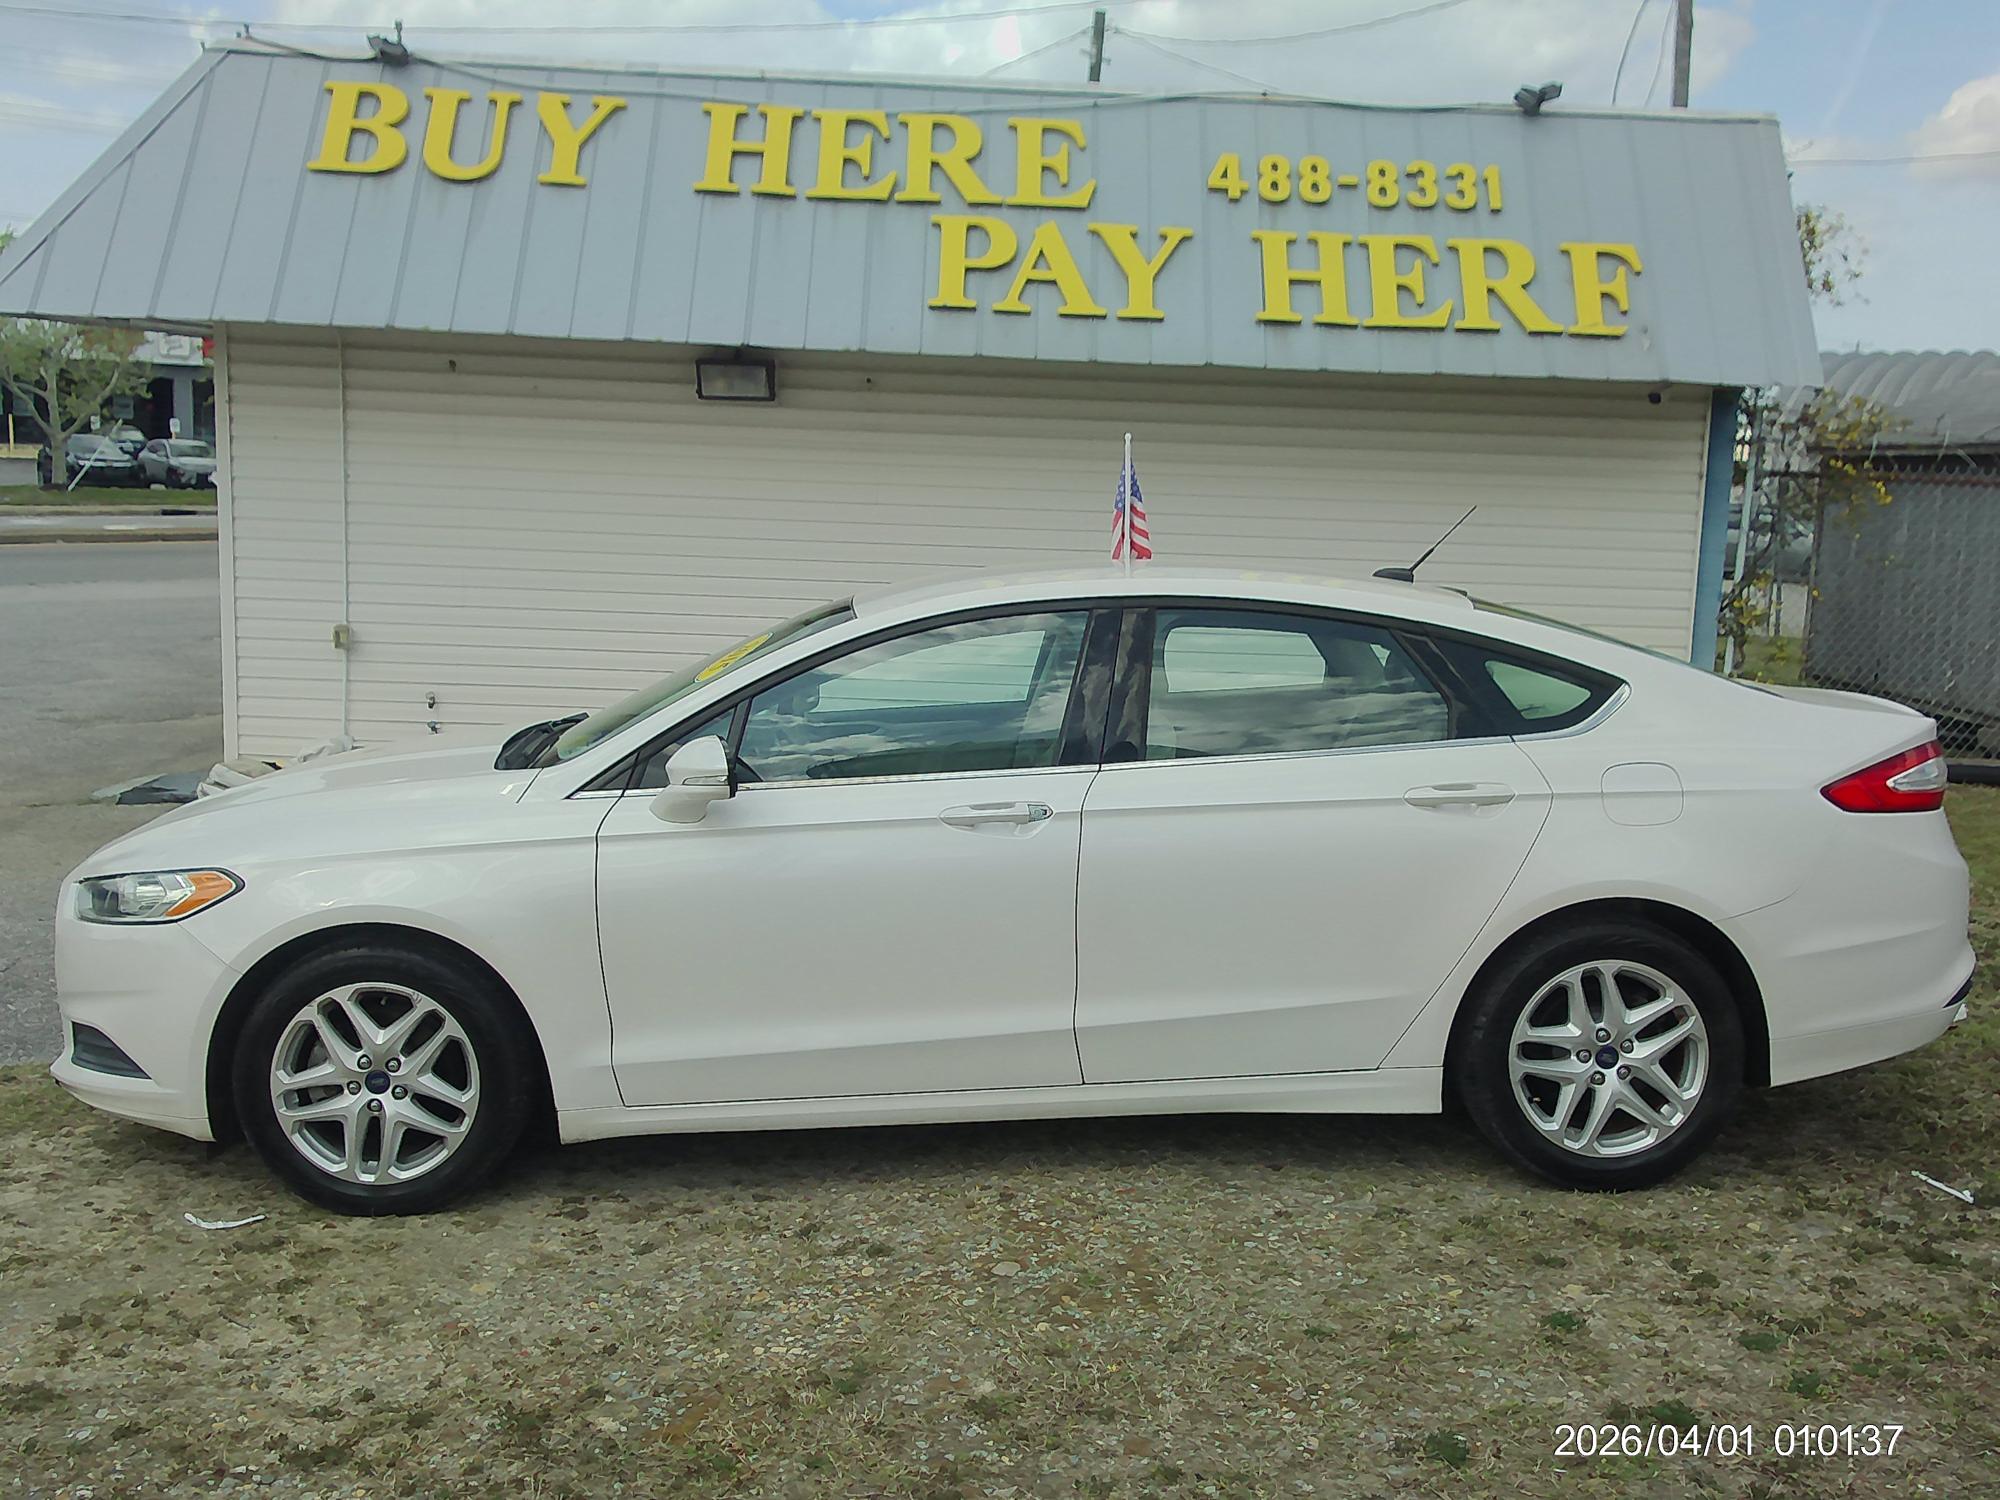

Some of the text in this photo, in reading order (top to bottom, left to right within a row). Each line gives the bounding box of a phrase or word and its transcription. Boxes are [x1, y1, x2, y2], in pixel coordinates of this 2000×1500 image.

[306, 80, 1096, 209] BUY HERE
[1207, 153, 1502, 212] 488-8331
[928, 215, 1193, 320] PAY
